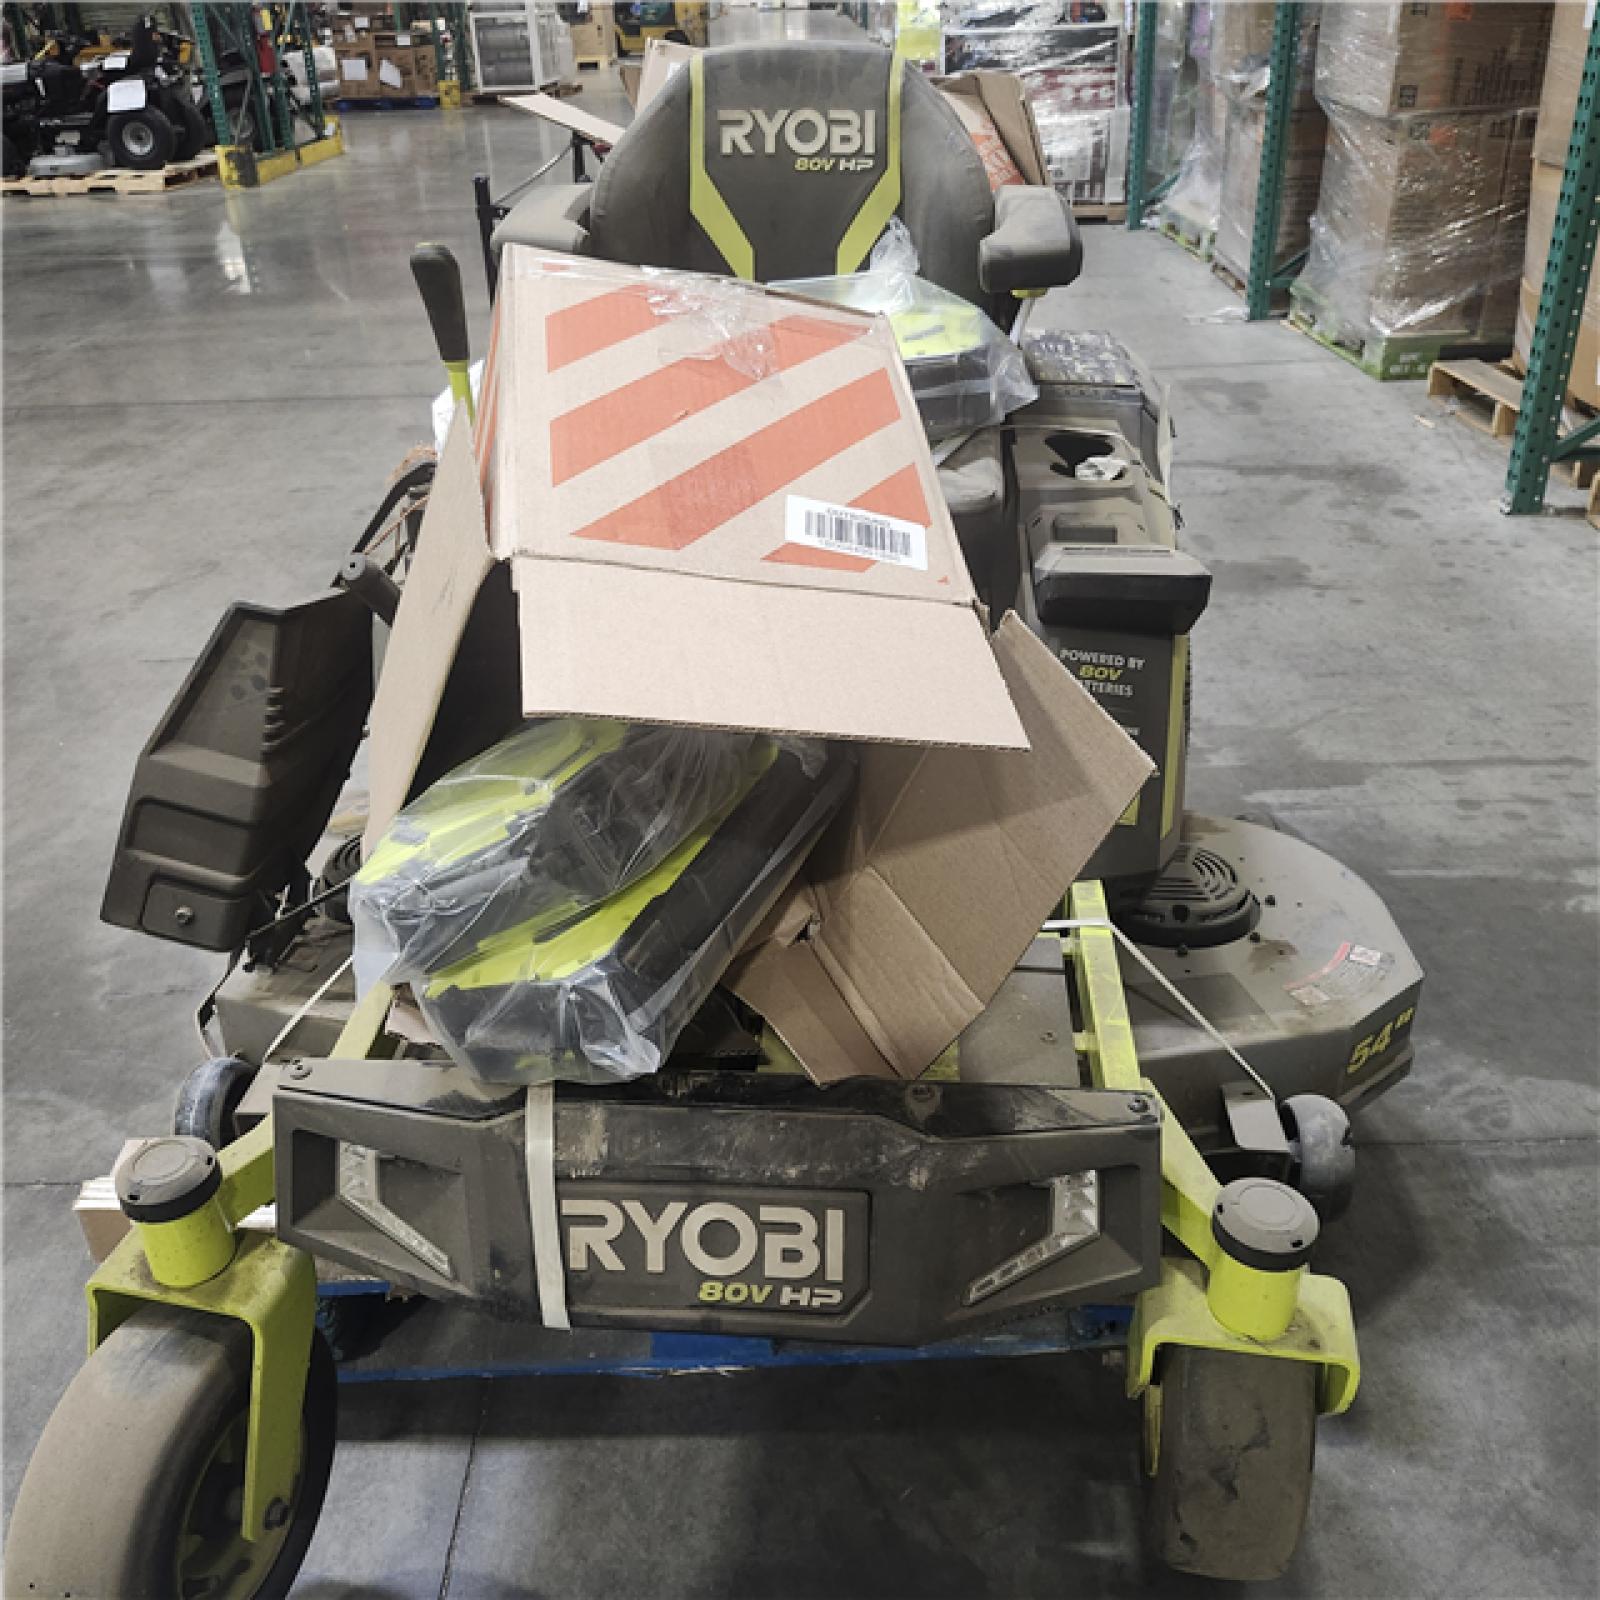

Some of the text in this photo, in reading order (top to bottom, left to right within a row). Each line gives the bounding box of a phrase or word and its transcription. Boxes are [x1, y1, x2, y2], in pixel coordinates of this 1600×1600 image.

[717, 109, 876, 155] RYOBI
[795, 157, 875, 171] 80V HP
[1079, 664, 1123, 681] 80V
[561, 1199, 844, 1281] RYOBI
[699, 1280, 843, 1307] 80V HP
